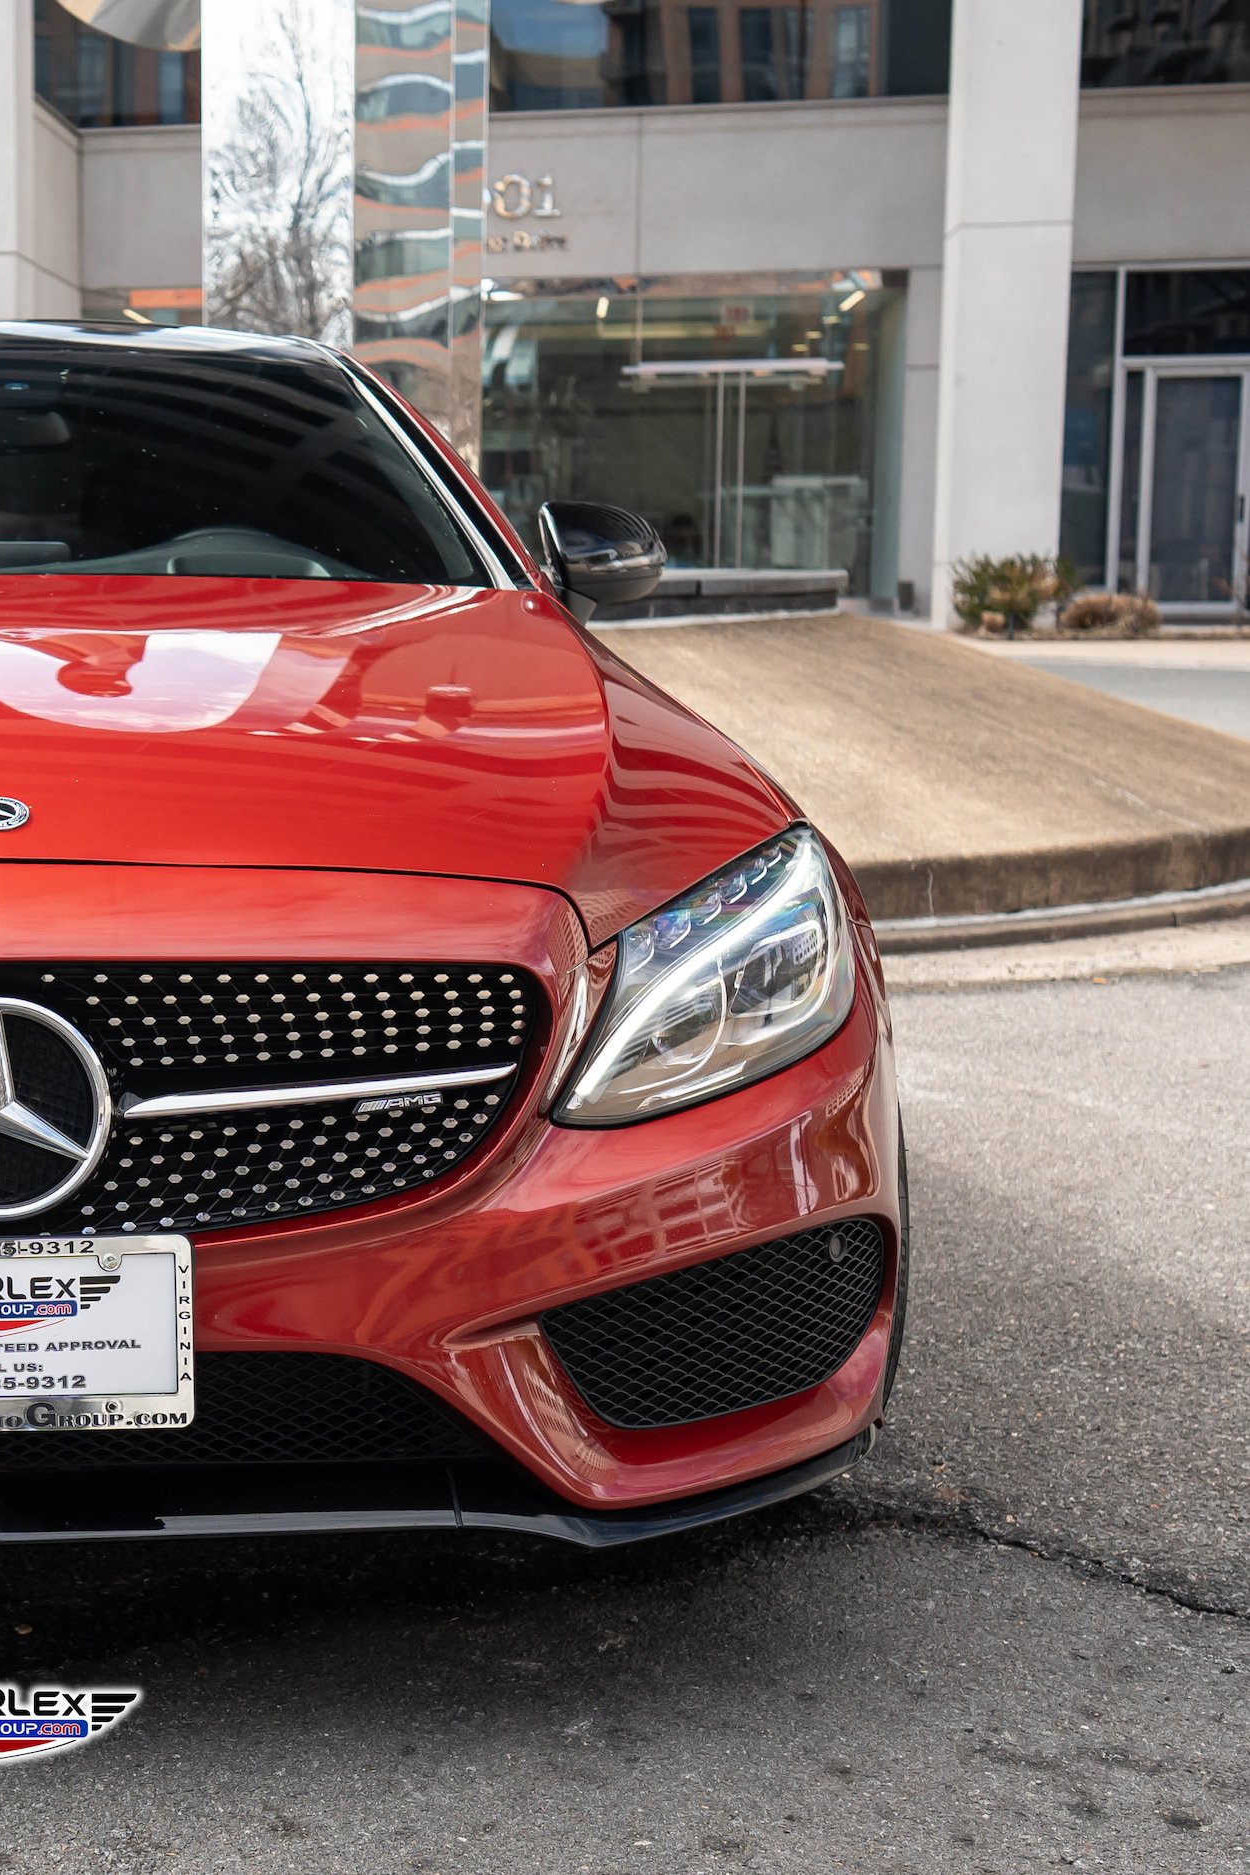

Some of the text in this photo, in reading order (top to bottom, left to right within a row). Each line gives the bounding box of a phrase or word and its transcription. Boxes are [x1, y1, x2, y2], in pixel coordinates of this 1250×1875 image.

[484, 174, 561, 218] 01
[384, 1094, 441, 1109] AMG
[178, 1265, 192, 1381] VIRGINIA
[44, 1339, 142, 1351] APPROVAL
[14, 1363, 43, 1372] US:
